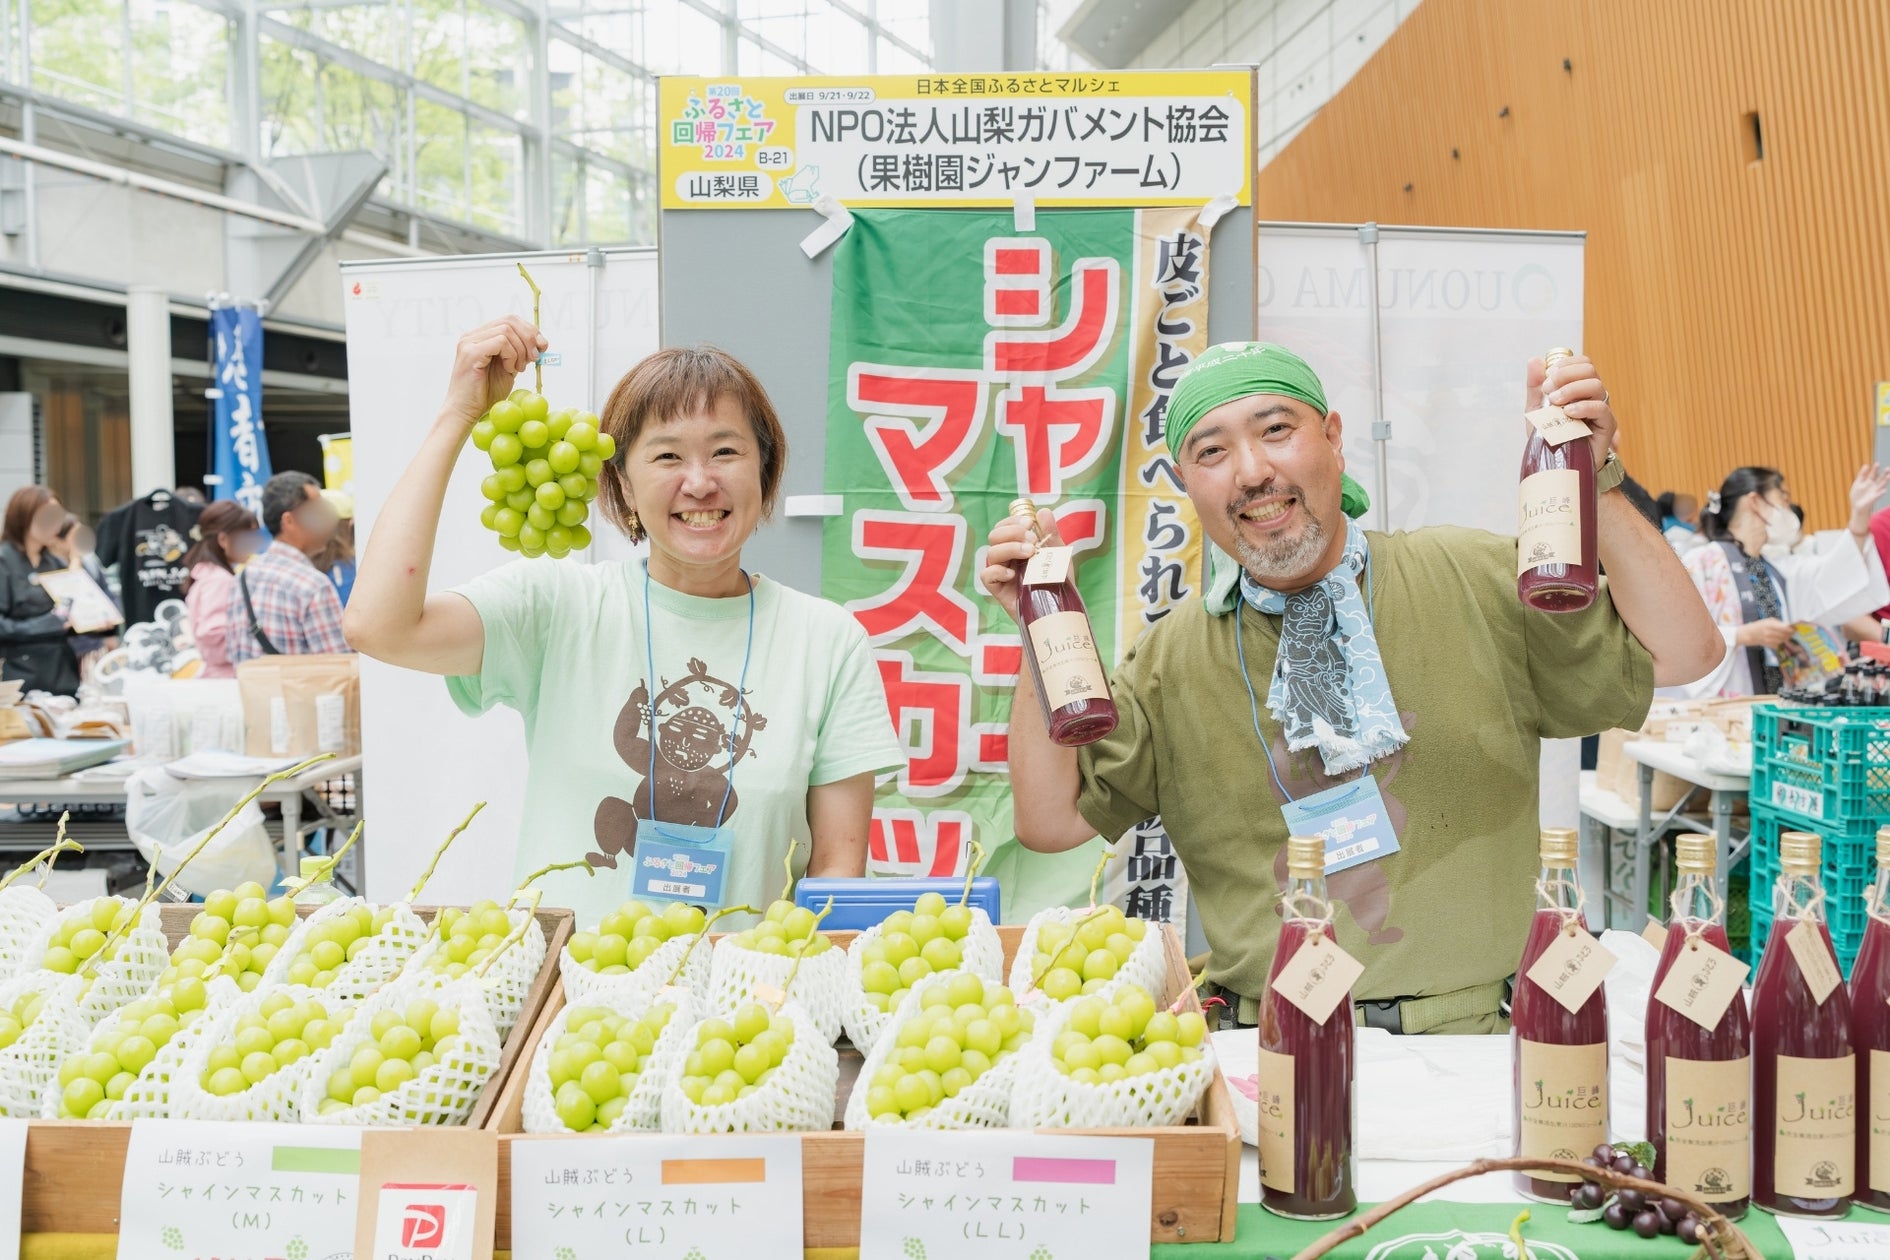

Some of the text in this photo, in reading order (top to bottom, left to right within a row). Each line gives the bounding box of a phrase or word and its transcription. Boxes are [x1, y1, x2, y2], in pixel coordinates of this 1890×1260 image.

[789, 91, 814, 100] 出展日
[916, 77, 1120, 95] 日本全国ふるさとマルシェ
[685, 98, 762, 119] ふるさと
[673, 121, 774, 143] 回帰フェア
[811, 104, 1229, 145] NPO法人山梨ガバメント協会
[704, 145, 744, 158] 2024
[759, 152, 788, 164] B-21
[857, 151, 1182, 192] (果樹園ジャンファーム)
[690, 176, 759, 198] 山梨県
[1041, 639, 1092, 664] Juice
[1525, 1082, 1601, 1110] Juice
[1671, 1098, 1746, 1129] Juice
[1782, 1092, 1853, 1122] Juice
[158, 1149, 245, 1168] 山賊ぶどう
[896, 1159, 985, 1178] 山賊ぶどう
[545, 1168, 633, 1186] 山賊ぶどう
[158, 1183, 347, 1204] シャインマスカット
[898, 1193, 1091, 1215] シャインマスカット
[548, 1197, 742, 1219] シャインマスカット
[232, 1211, 272, 1230] (M)
[626, 1225, 666, 1246] (L)
